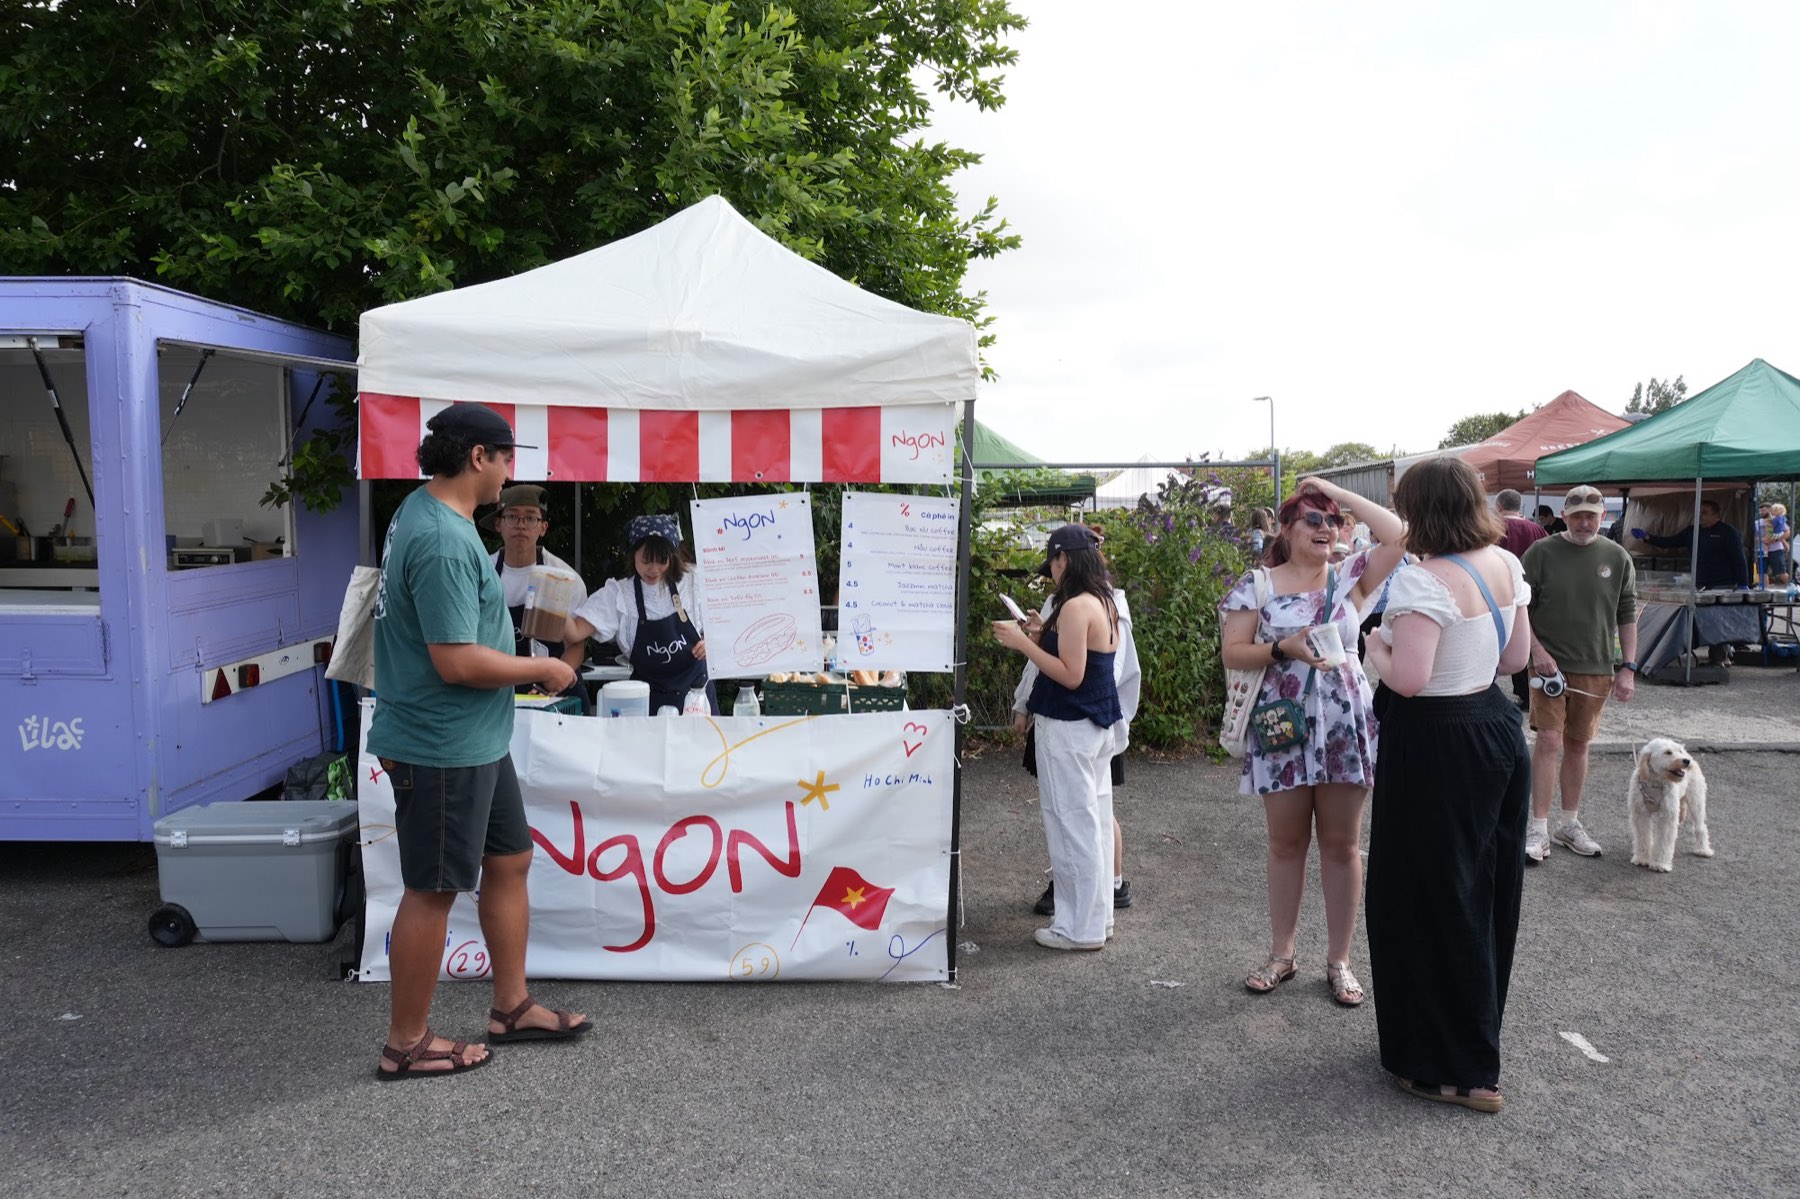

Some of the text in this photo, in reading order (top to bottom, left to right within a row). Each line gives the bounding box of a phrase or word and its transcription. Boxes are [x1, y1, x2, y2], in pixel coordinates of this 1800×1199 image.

[931, 527, 955, 536] coffee
[929, 545, 954, 554] coffee
[847, 560, 852, 568] 5
[928, 563, 952, 572] coffee
[846, 580, 858, 588] 4.5
[845, 601, 858, 609] 4.5
[863, 773, 932, 789] Ho Chi Minh
[742, 956, 770, 976] 59
